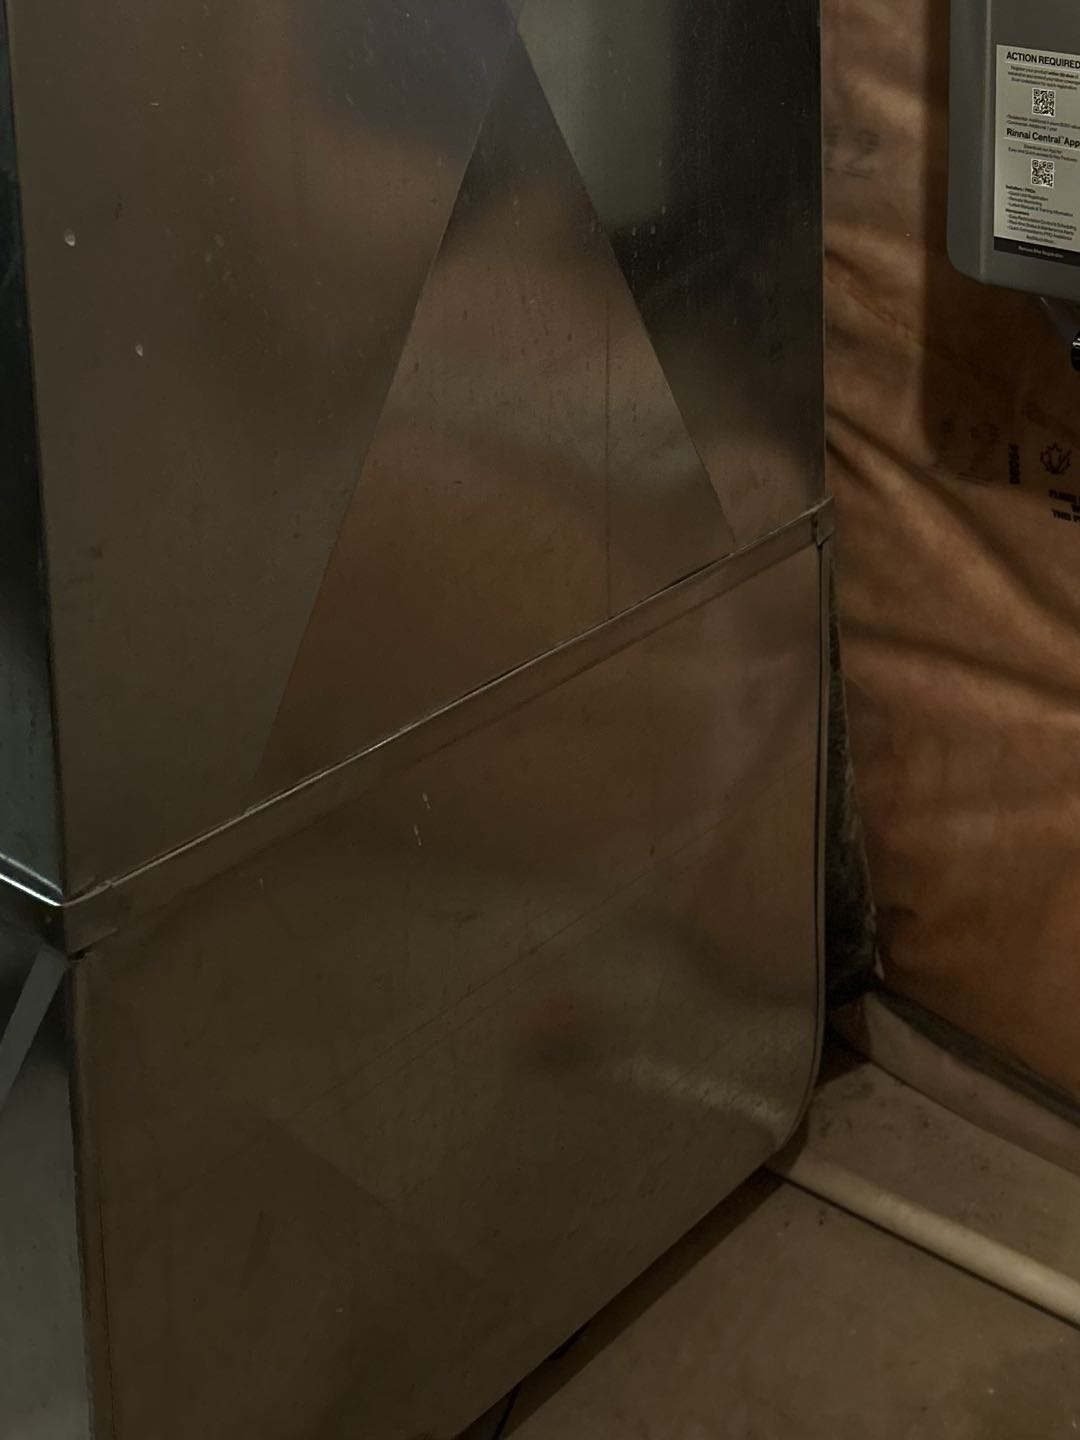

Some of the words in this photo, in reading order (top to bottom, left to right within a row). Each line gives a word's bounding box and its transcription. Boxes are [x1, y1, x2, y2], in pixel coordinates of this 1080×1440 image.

[1006, 51, 1037, 63] ACTION
[1006, 128, 1031, 139] Rinnai
[1064, 137, 1080, 148] App
